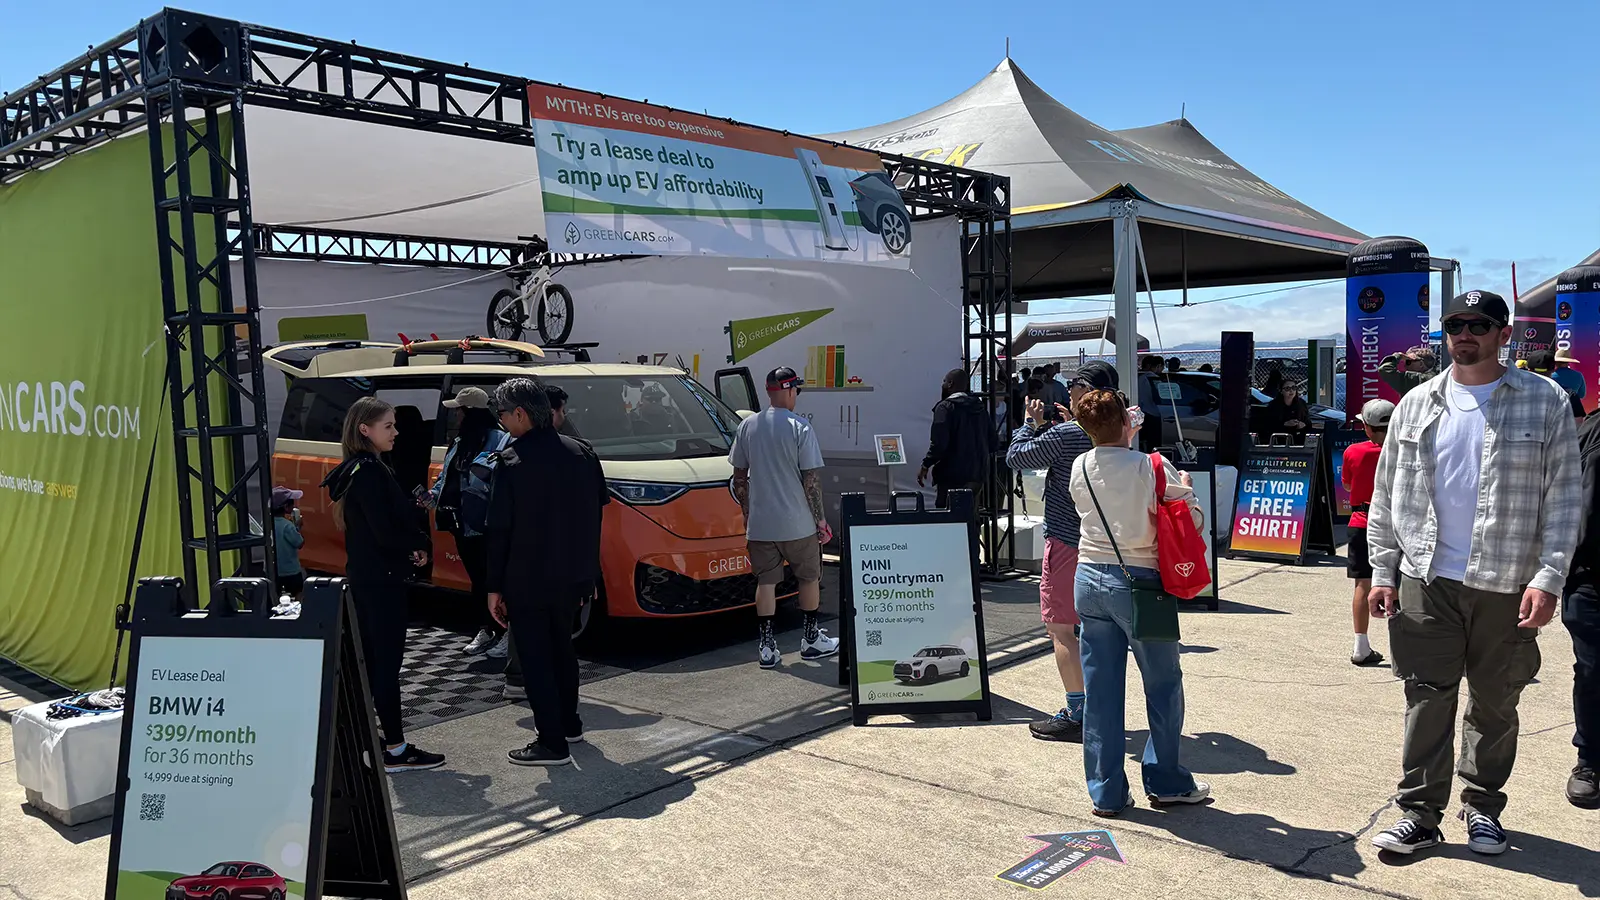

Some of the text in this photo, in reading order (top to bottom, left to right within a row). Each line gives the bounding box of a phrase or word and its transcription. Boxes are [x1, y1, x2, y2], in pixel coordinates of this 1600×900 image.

[545, 95, 725, 139] MYTH: EVs are too expensive
[551, 132, 714, 169] Try a lease deal to
[557, 168, 764, 205] amp up EV affordability
[748, 317, 800, 340] GREENCARS
[1362, 325, 1379, 373] CHECK
[1515, 350, 1530, 359] EXP
[16, 477, 28, 492] we
[1243, 479, 1304, 496] GET YOUR
[1249, 497, 1294, 517] FREE
[1238, 517, 1299, 539] SHIRT!
[859, 542, 908, 551] EV Lease Deal
[861, 558, 891, 571] MINI
[862, 571, 944, 588] Countryman
[862, 588, 935, 600] $299/month
[863, 601, 935, 613] for 36 months
[884, 616, 896, 624] due
[902, 616, 924, 624] signing
[151, 669, 226, 682] EV Lease Deal
[148, 696, 225, 717] BMW i4
[146, 724, 257, 745] $399/month
[144, 746, 254, 766] for 36 months
[143, 772, 234, 787] $4,999 due at signing
[1043, 851, 1086, 875] OUTDOOR
[1027, 872, 1050, 885] REC
